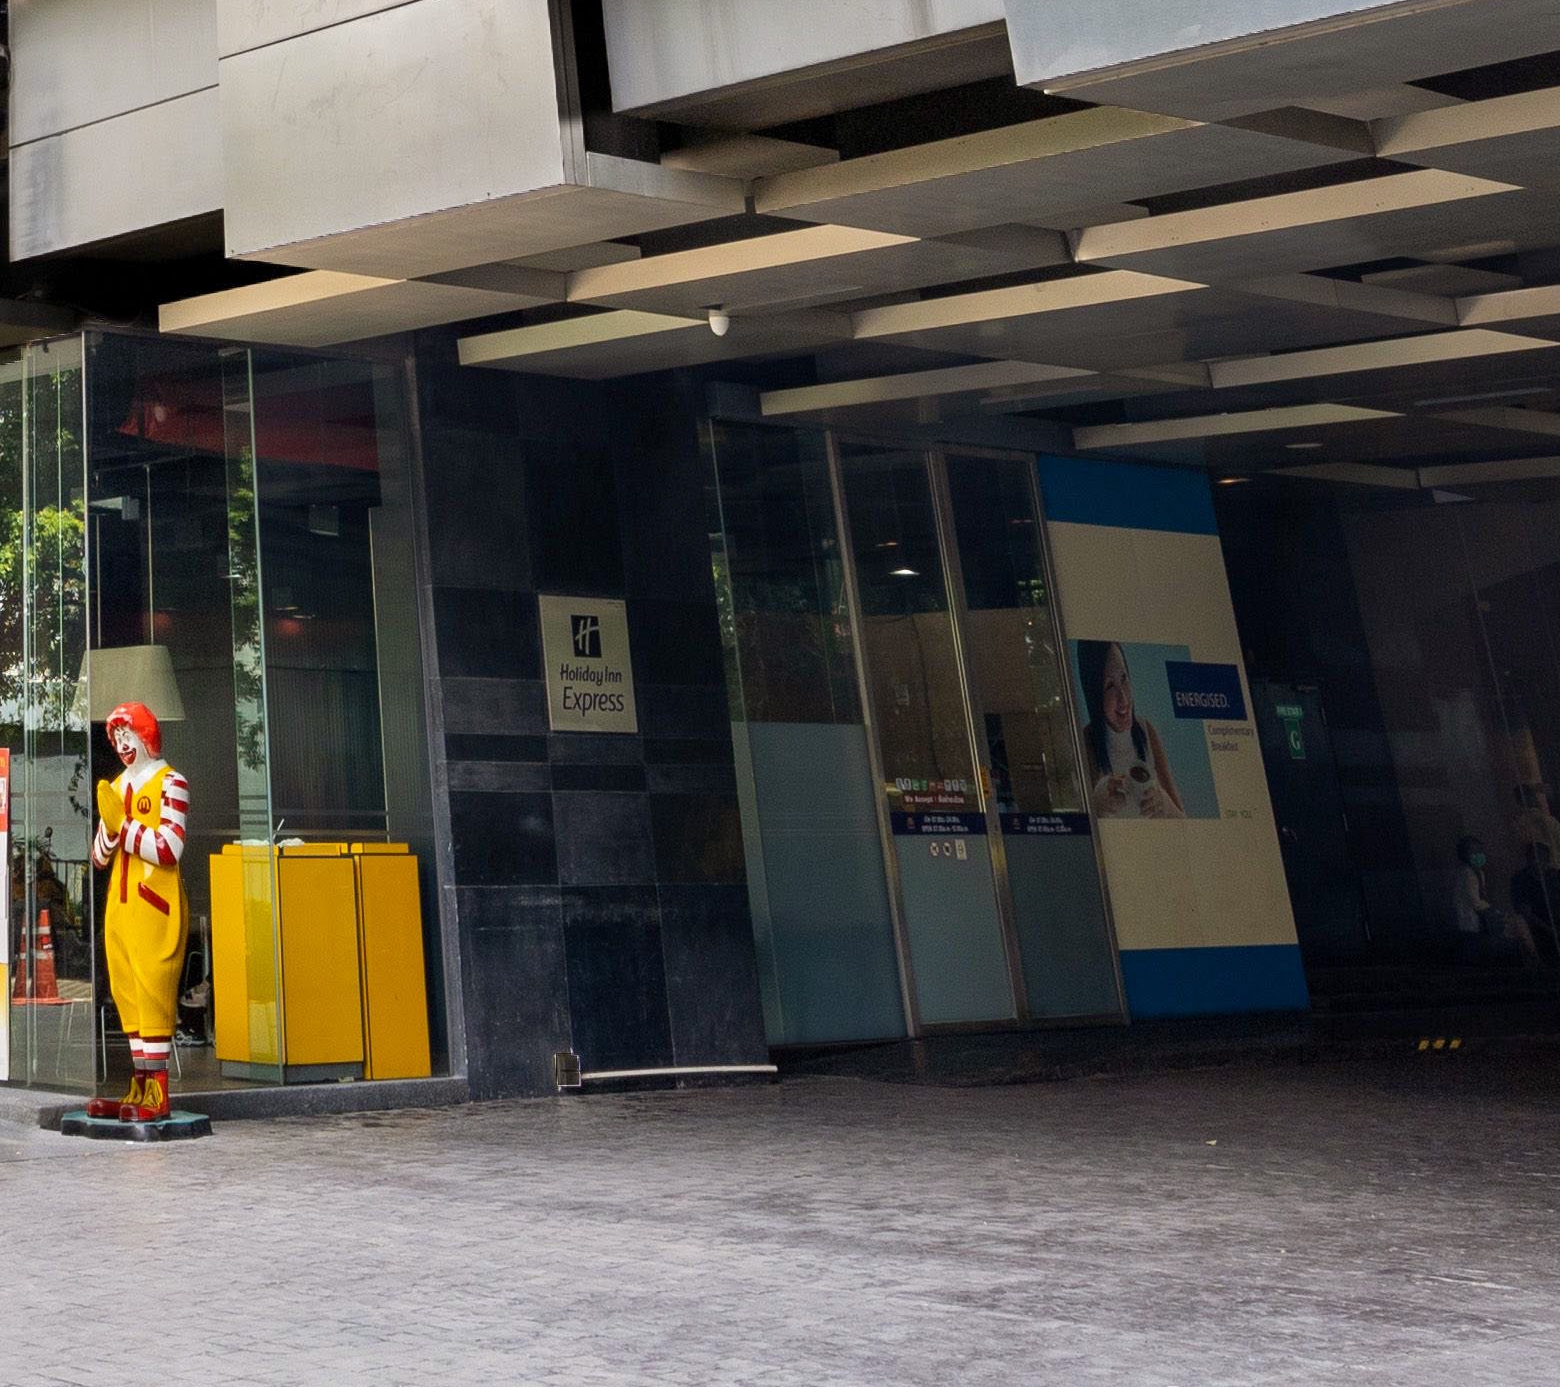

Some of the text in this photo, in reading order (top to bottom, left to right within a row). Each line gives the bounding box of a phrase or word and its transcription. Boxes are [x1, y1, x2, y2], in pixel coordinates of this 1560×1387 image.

[560, 663, 623, 686] Holiday Inn
[562, 686, 625, 717] Express
[1176, 691, 1231, 708] ENERGISED.
